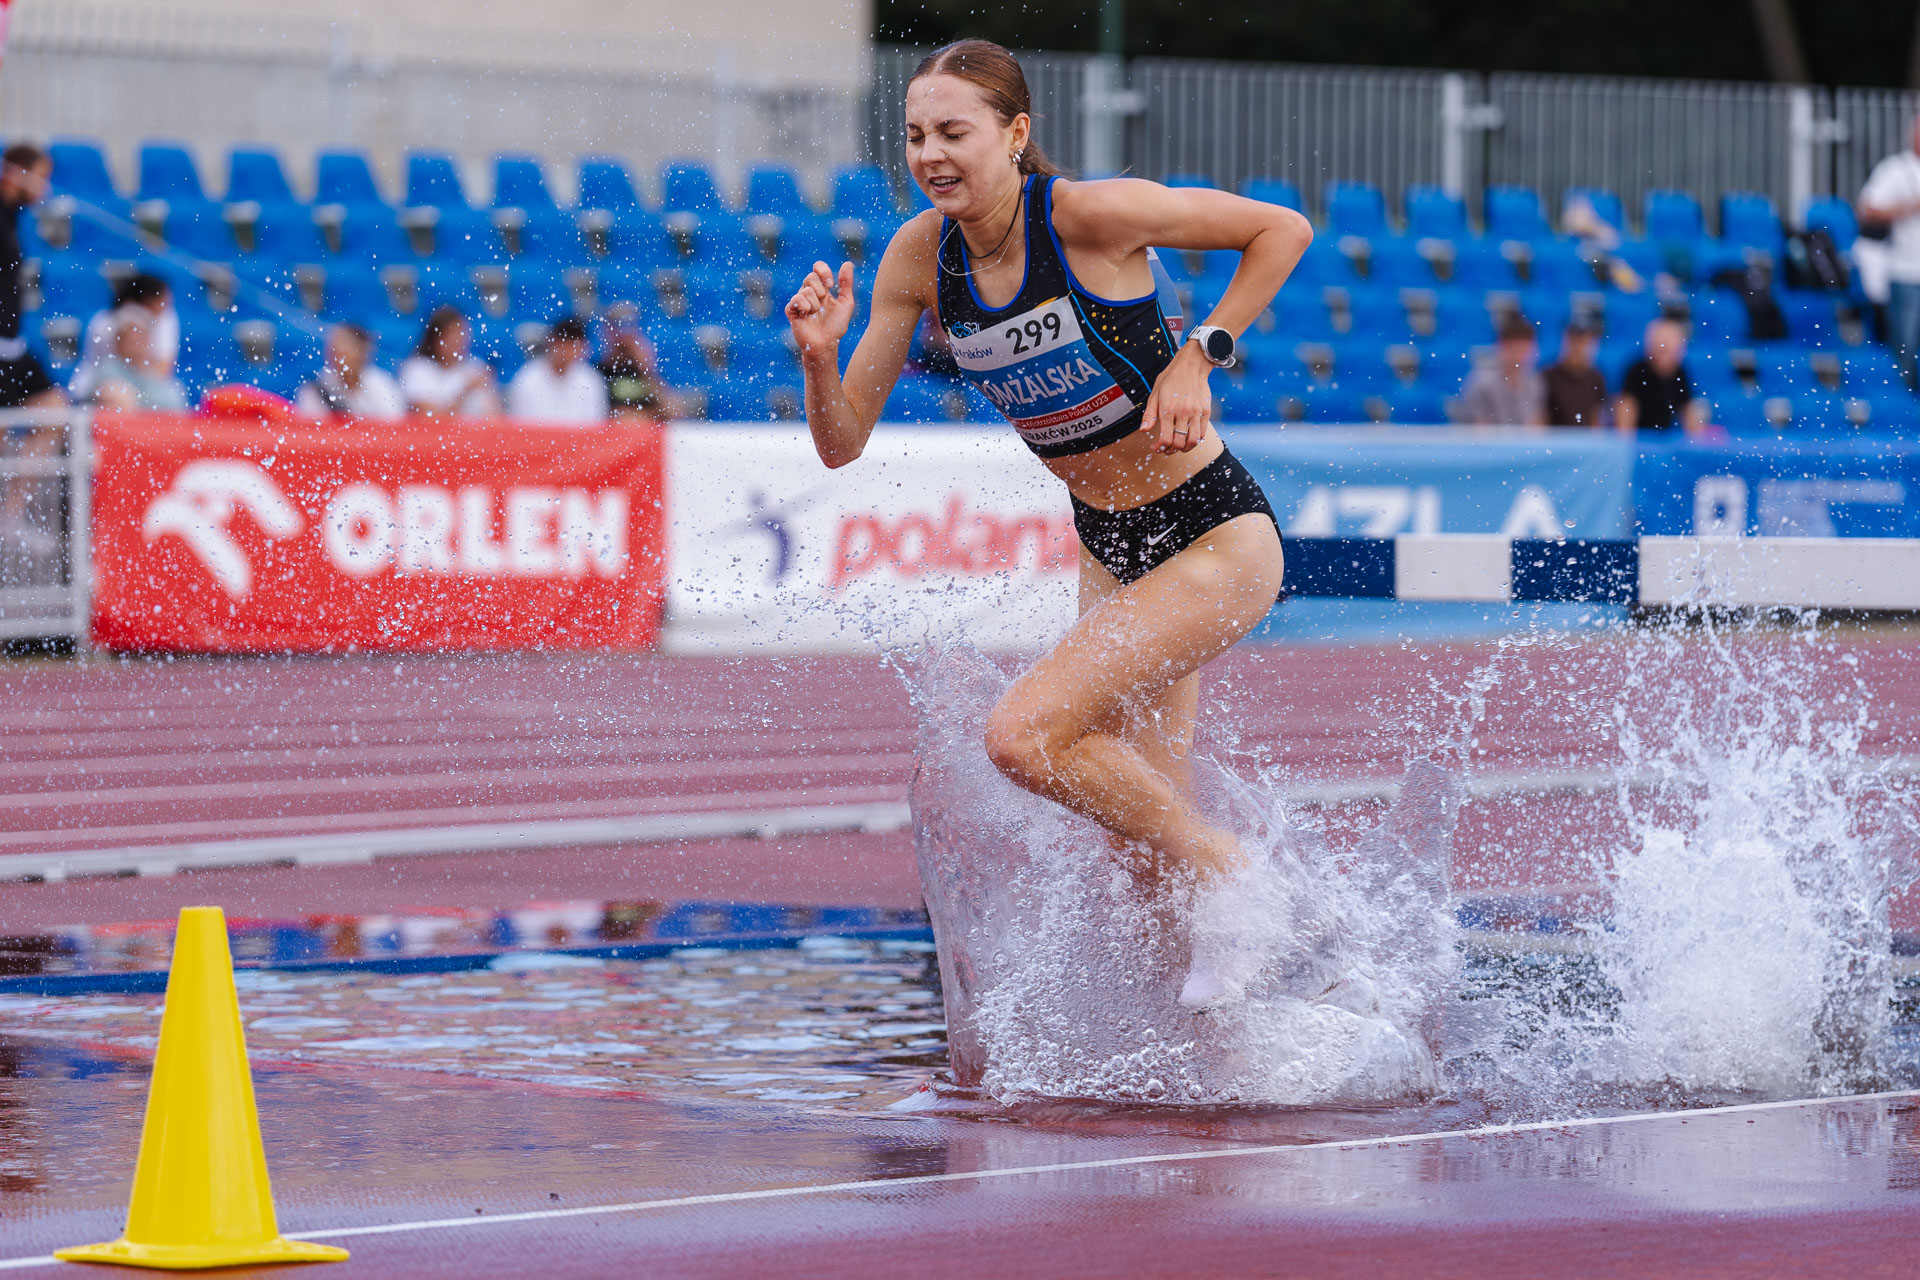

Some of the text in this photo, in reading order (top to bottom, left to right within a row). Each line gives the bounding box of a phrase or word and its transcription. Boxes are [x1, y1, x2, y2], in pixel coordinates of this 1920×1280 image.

[1005, 312, 1061, 355] 299
[1068, 405, 1093, 418] Polski
[1091, 394, 1109, 408] U23
[1023, 415, 1103, 442] KRAKÓW 2025
[321, 484, 630, 578] ORLEN
